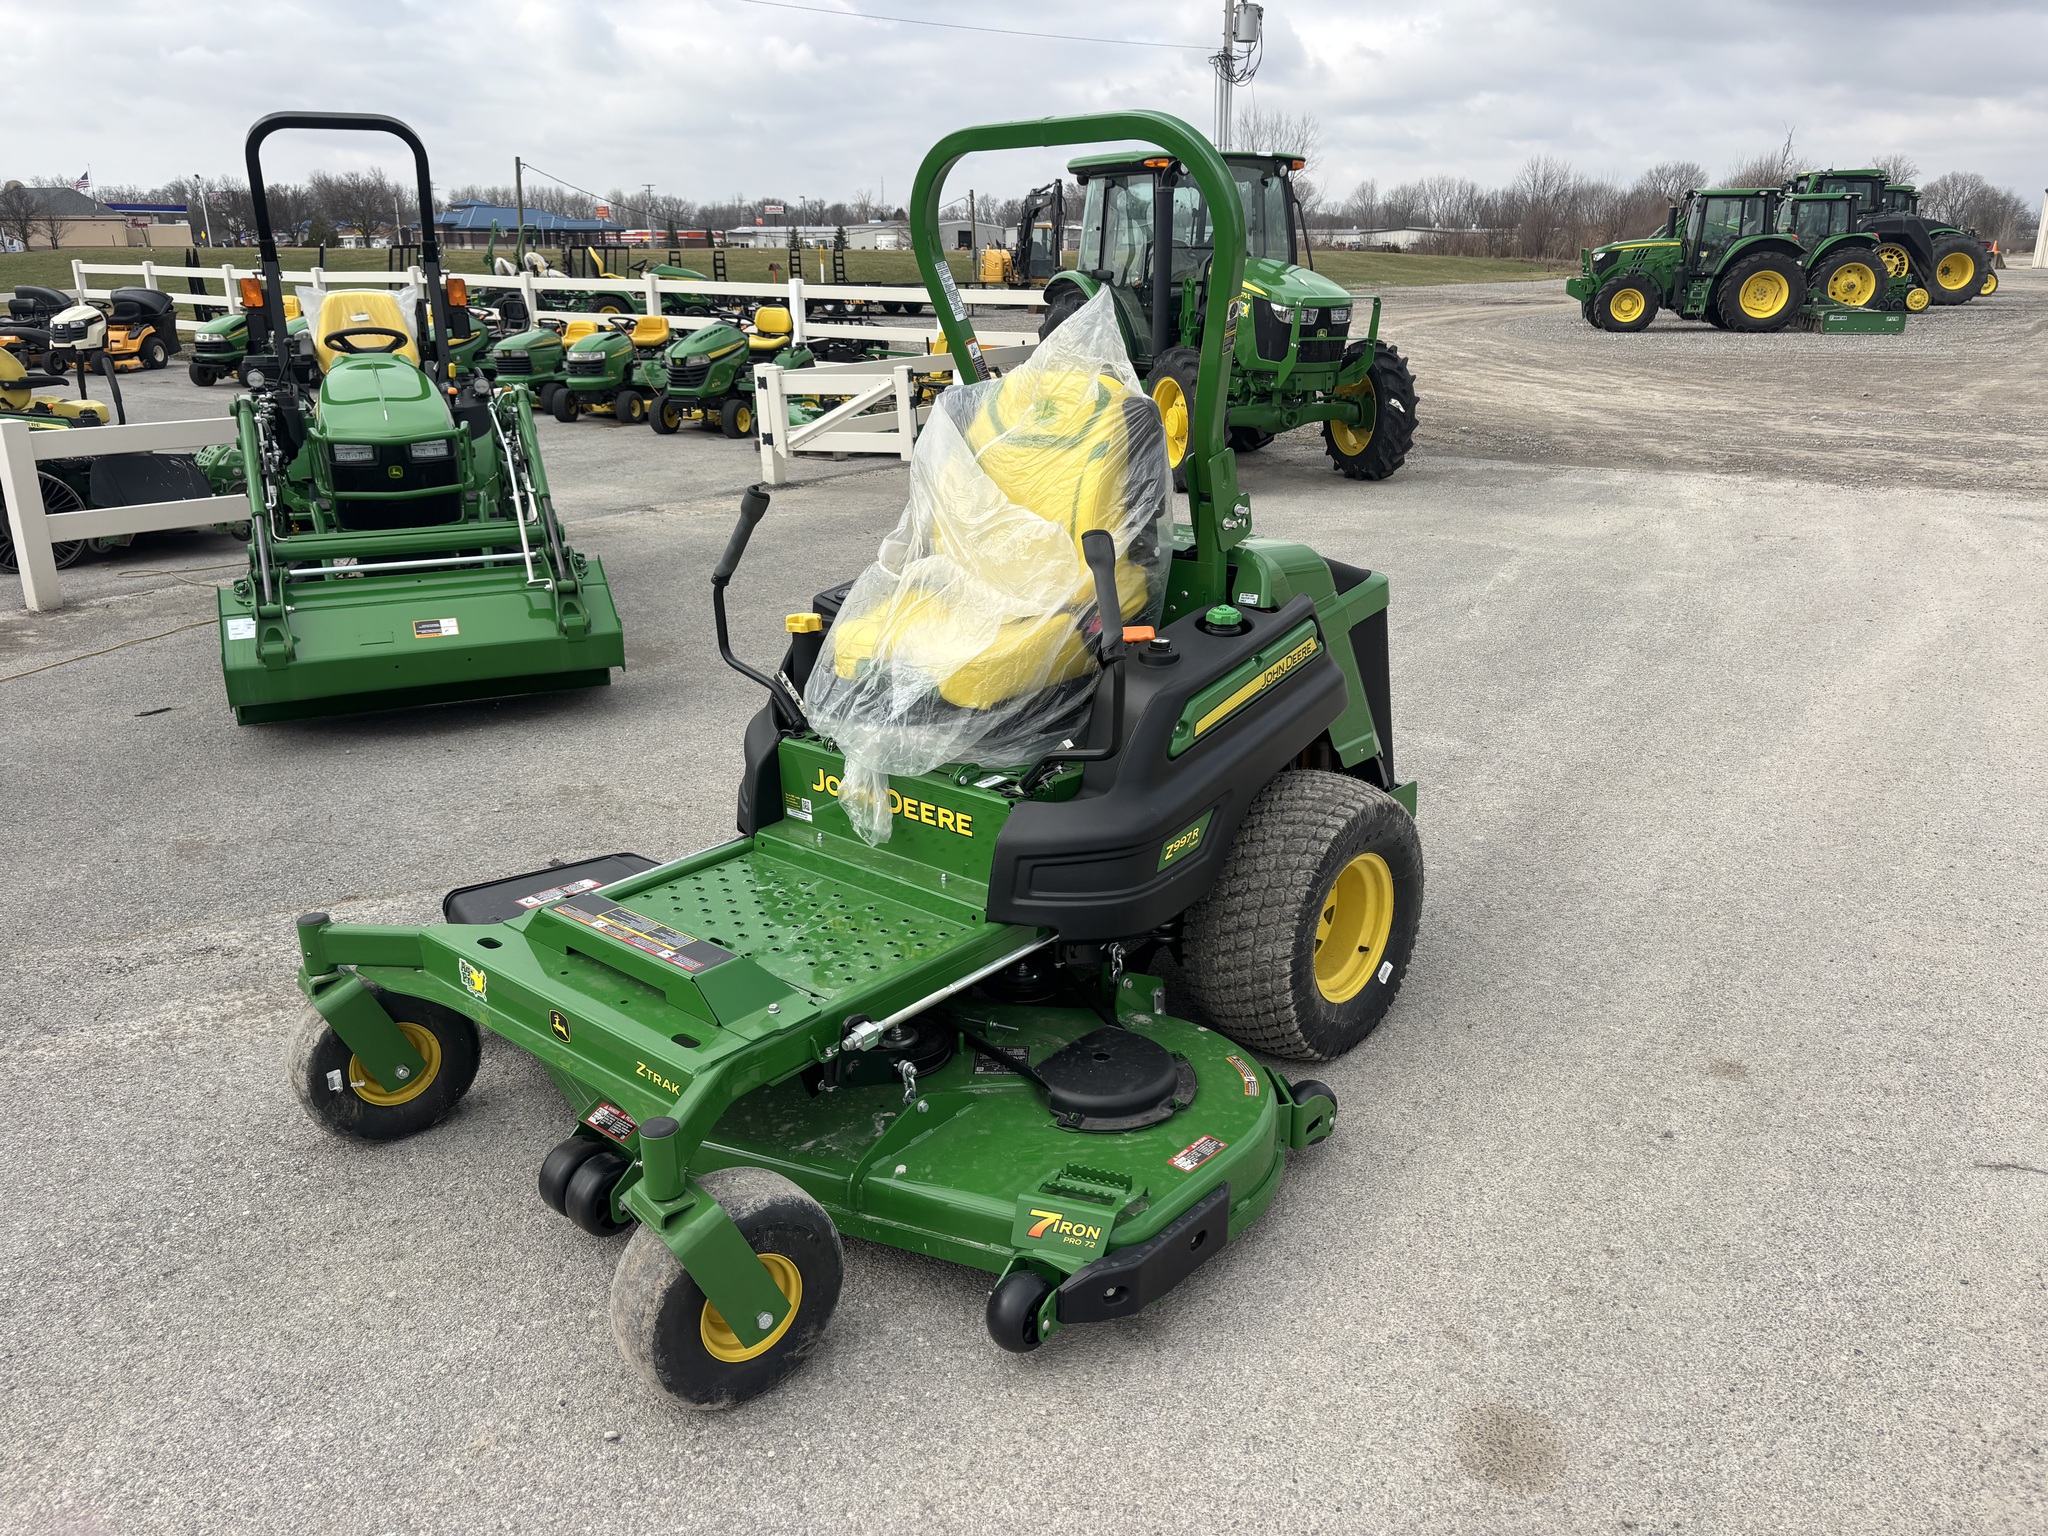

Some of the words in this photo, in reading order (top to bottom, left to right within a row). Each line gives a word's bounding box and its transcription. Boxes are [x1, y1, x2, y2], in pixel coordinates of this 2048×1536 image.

[1261, 661, 1285, 688] JOHN
[1286, 642, 1313, 670] DEERE
[884, 788, 973, 838] DEERE
[1164, 827, 1200, 861] Z997R
[635, 1060, 681, 1097] ZTRAK
[1062, 1236, 1083, 1247] PRO
[1084, 1239, 1097, 1249] 72
